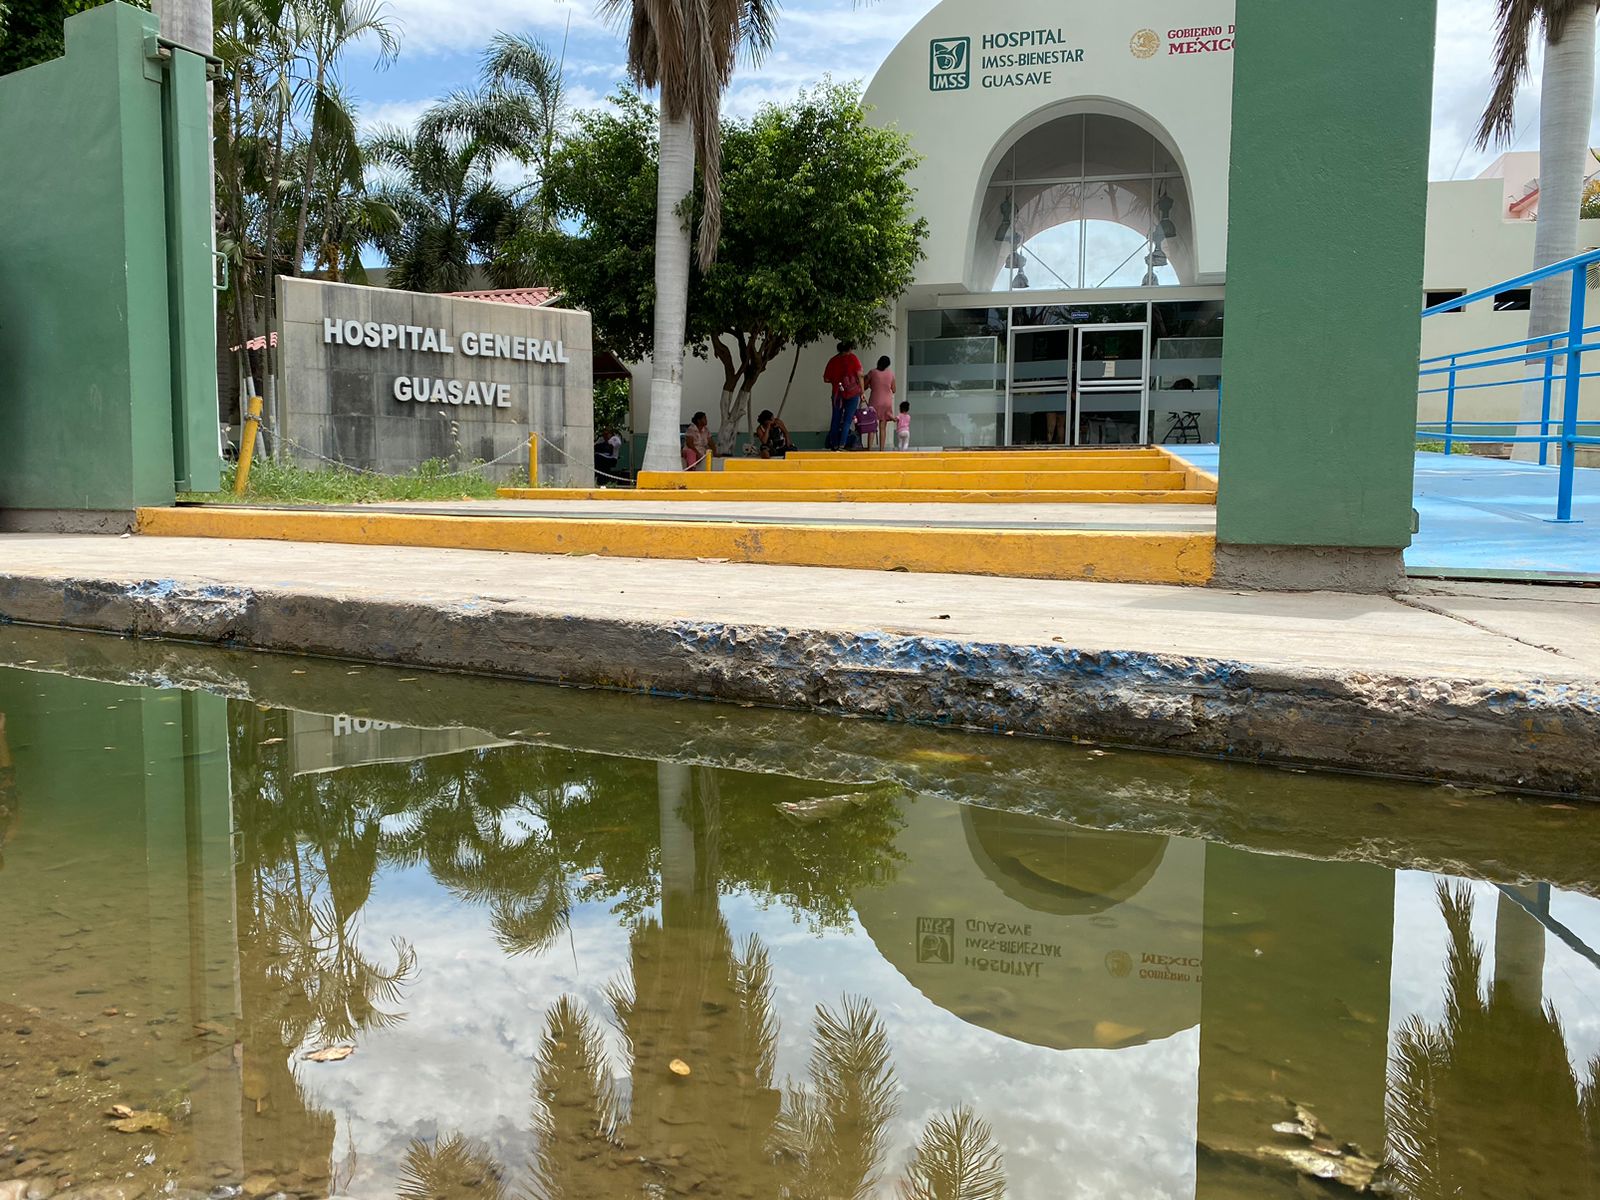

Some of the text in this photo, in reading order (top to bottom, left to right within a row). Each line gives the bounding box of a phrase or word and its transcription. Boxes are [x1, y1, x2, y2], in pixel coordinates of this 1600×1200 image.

[982, 28, 1066, 49] HOSPITAL
[1167, 25, 1222, 39] GOBIERNO
[982, 49, 1085, 69] IMSS-BIENESTAR
[933, 74, 967, 89] IMSS
[982, 71, 1052, 88] GUASAVE
[323, 317, 570, 364] HOSPITAL GENERAL
[393, 376, 511, 408] GUASAVE
